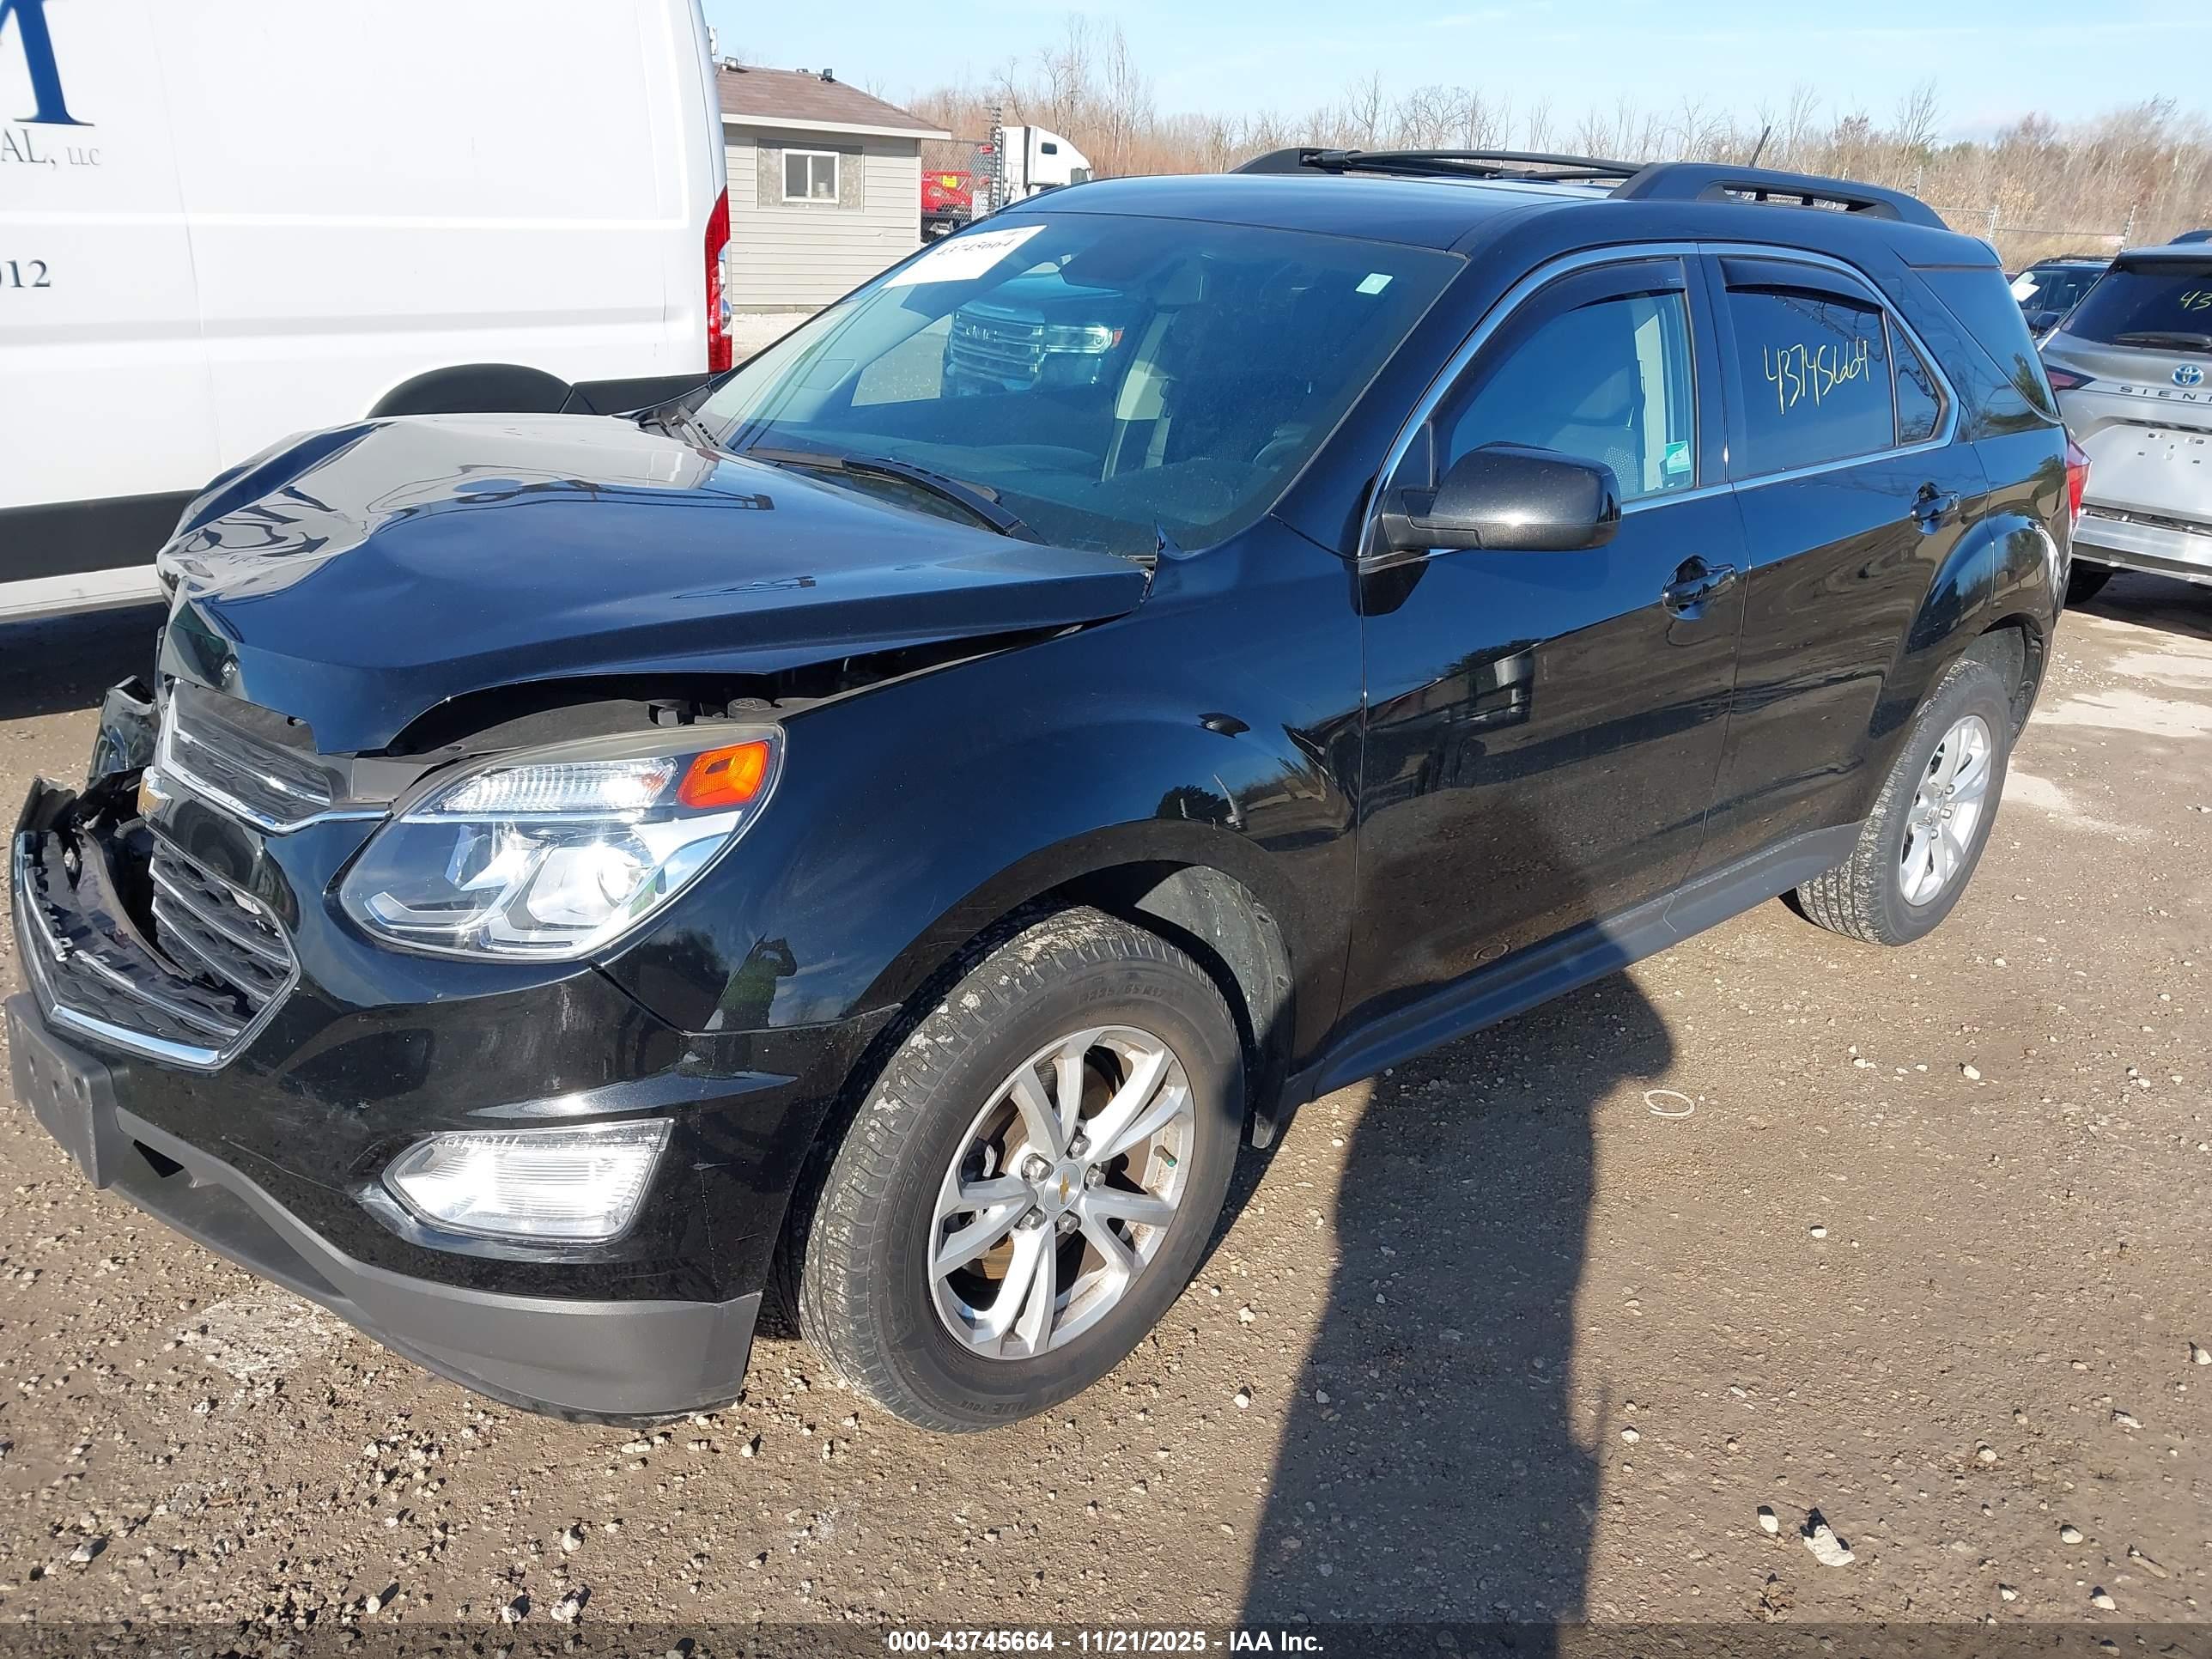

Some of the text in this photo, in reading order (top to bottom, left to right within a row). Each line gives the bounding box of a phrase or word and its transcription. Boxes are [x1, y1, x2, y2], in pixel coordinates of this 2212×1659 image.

[67, 147, 101, 166] LLC
[0, 259, 52, 288] 12
[2119, 386, 2212, 403] SIEN
